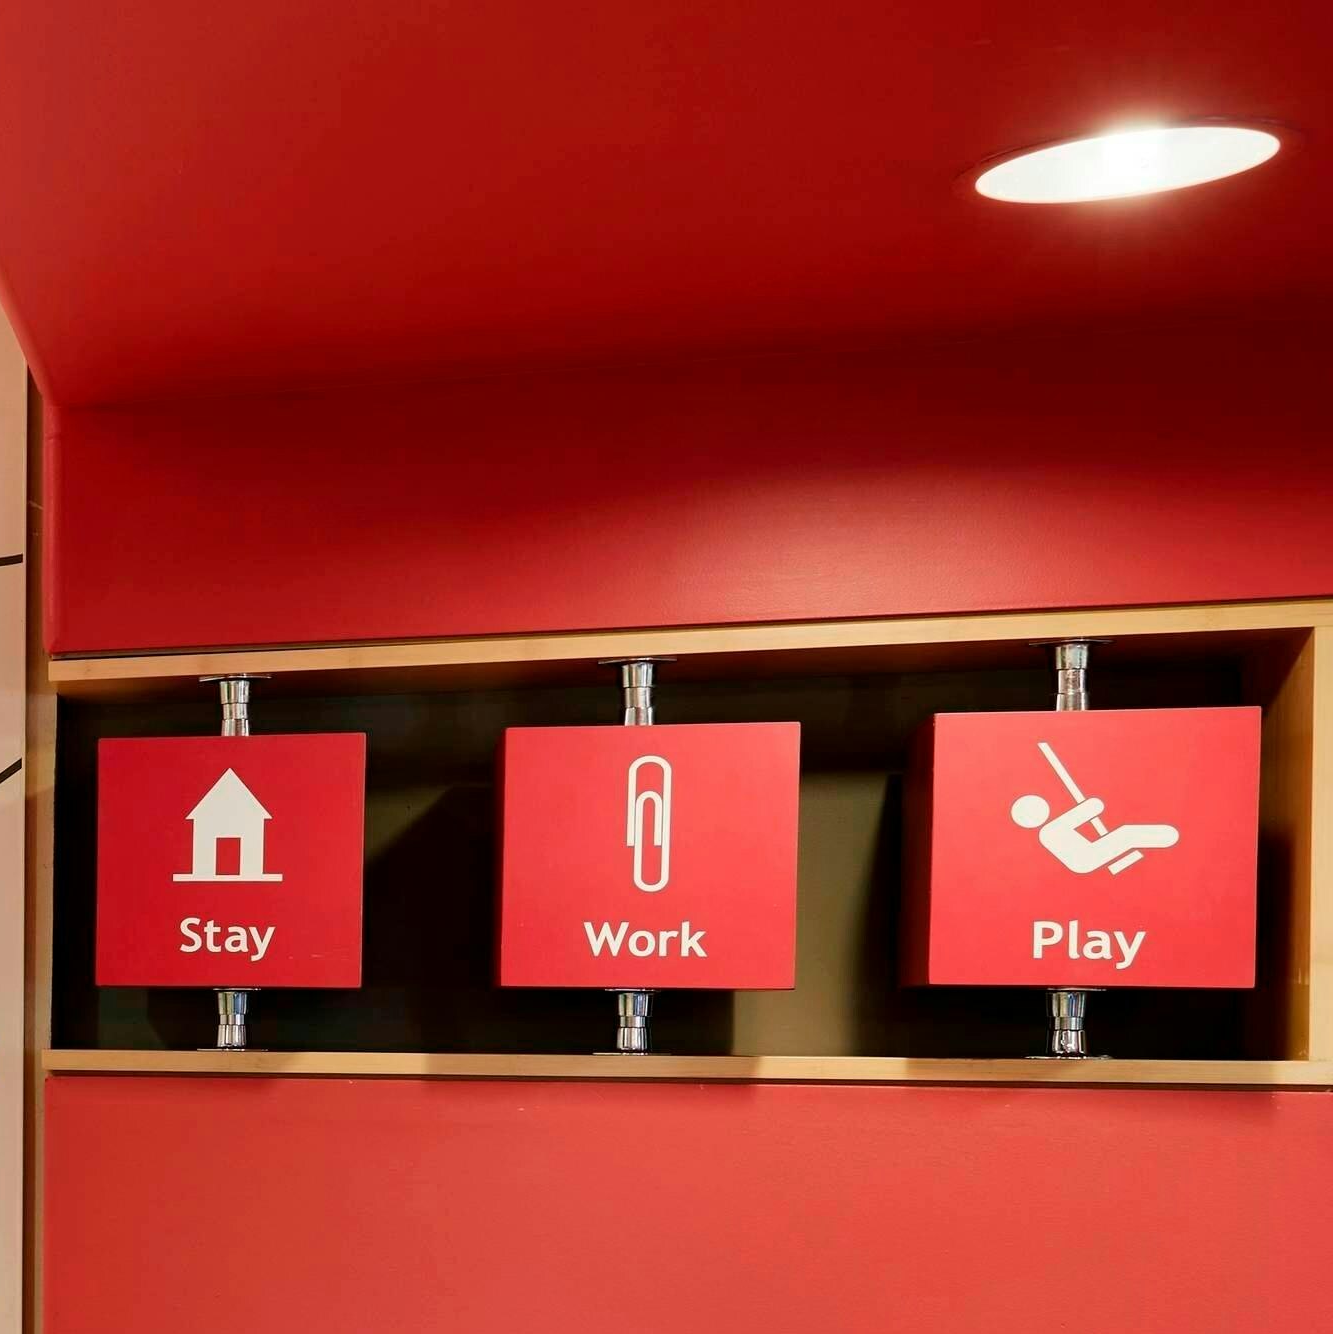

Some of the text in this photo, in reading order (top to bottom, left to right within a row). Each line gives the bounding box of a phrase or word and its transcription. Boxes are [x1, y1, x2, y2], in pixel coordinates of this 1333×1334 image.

[179, 916, 276, 963] Stay
[583, 920, 707, 959] Work
[1032, 920, 1147, 970] Play
